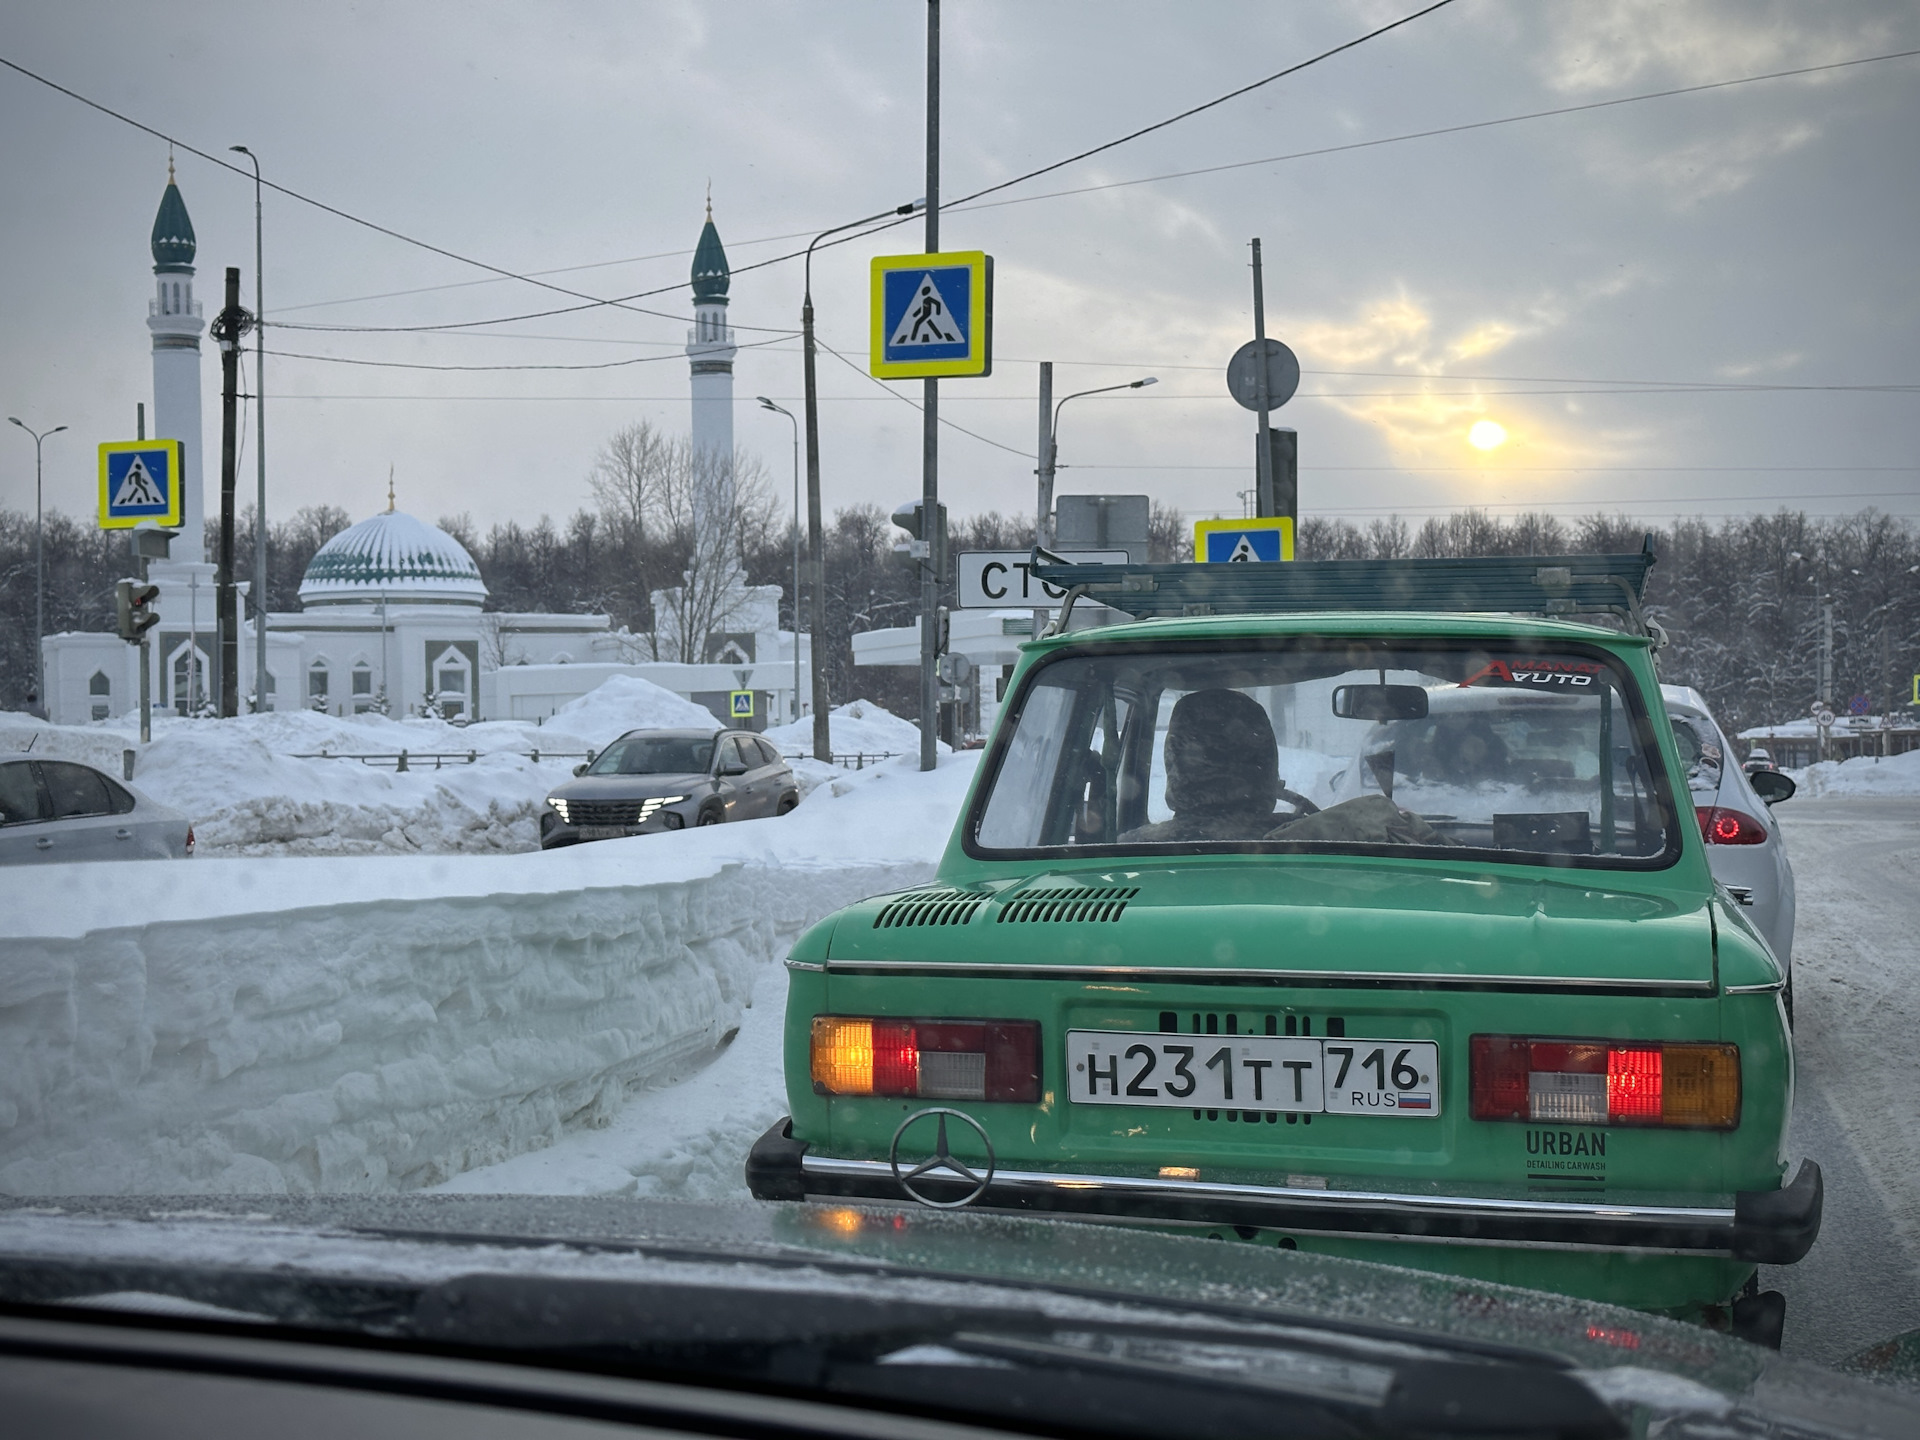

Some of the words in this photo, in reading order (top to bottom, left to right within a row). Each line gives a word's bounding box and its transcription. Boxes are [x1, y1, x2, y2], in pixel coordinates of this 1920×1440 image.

[1820, 714, 1832, 722] 40
[1087, 1043, 1312, 1103] Н231ТТ
[1327, 1047, 1420, 1091] 716
[1351, 1091, 1396, 1107] RUS
[1526, 1130, 1606, 1156] URBAN
[1526, 1159, 1565, 1170] DETAILING
[1566, 1161, 1606, 1171] CARWASH
